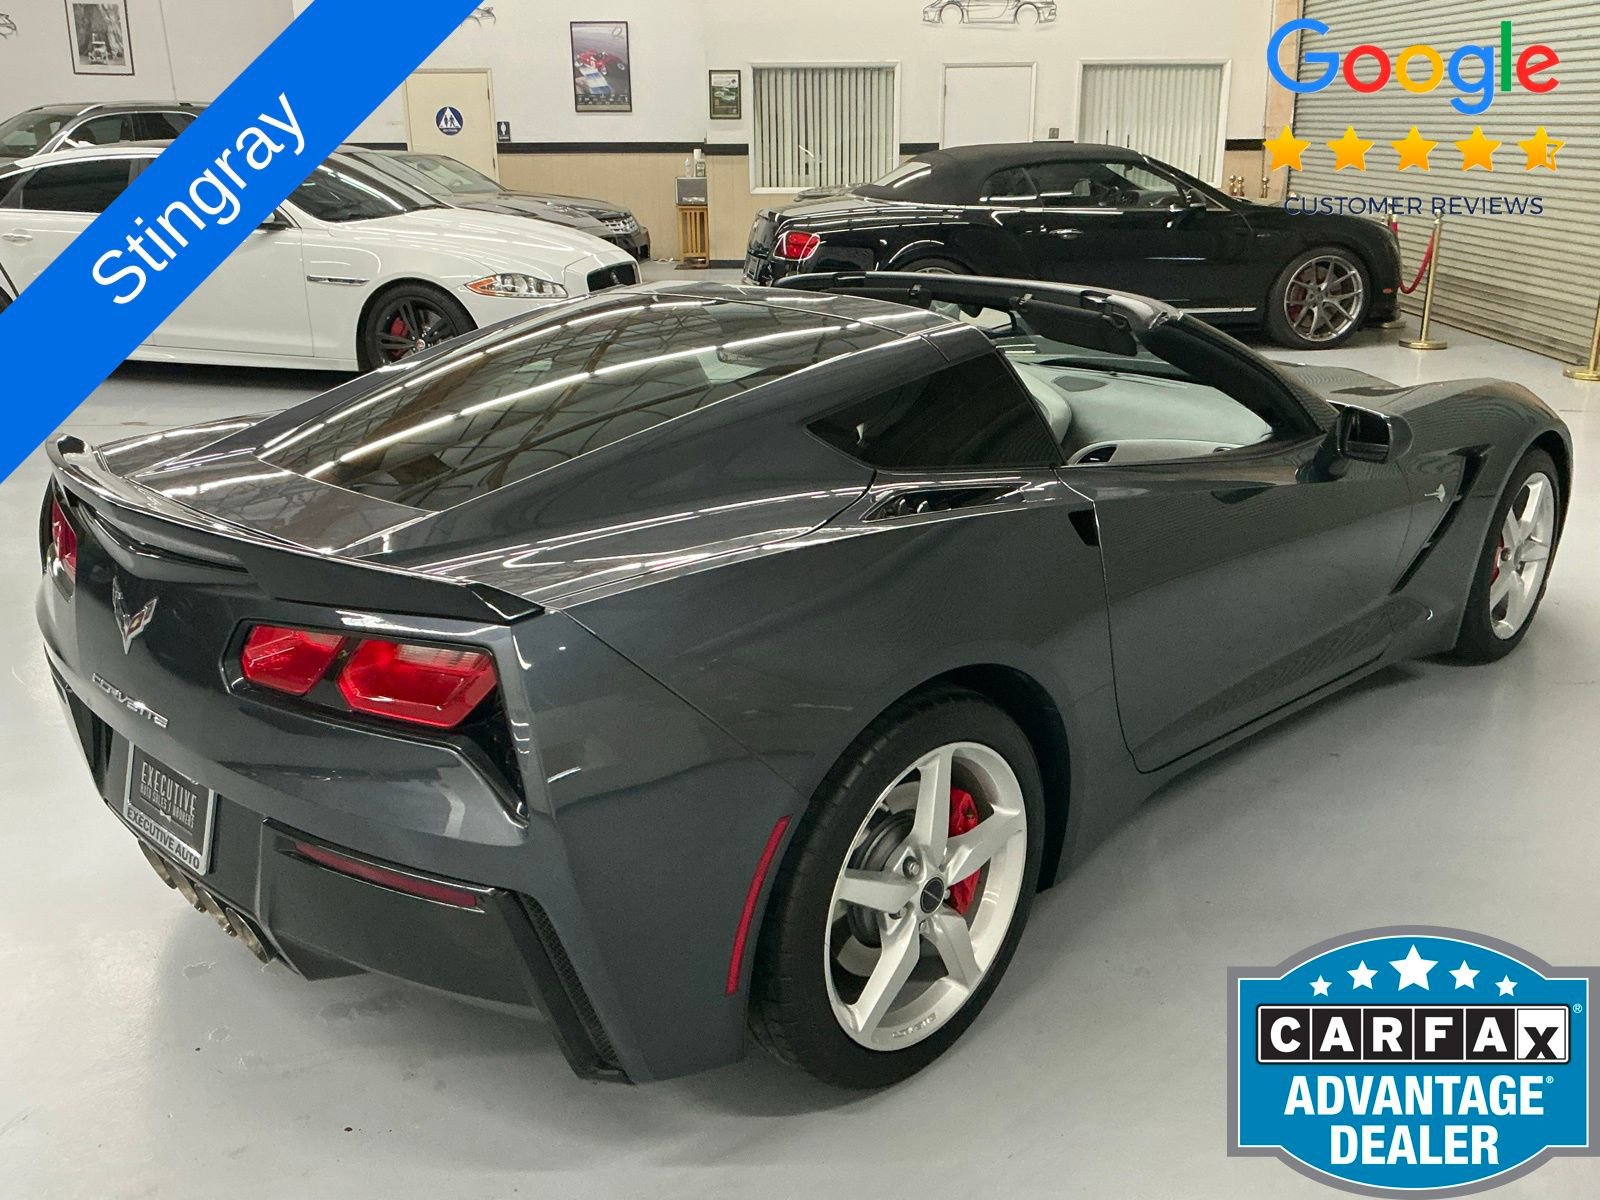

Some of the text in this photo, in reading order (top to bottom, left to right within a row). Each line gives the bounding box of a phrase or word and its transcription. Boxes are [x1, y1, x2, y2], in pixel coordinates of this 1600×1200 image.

[92, 672, 169, 728] CORVETTE
[140, 760, 197, 818] EXECUTIVE
[127, 809, 200, 870] EXECUTIVE AUTO
